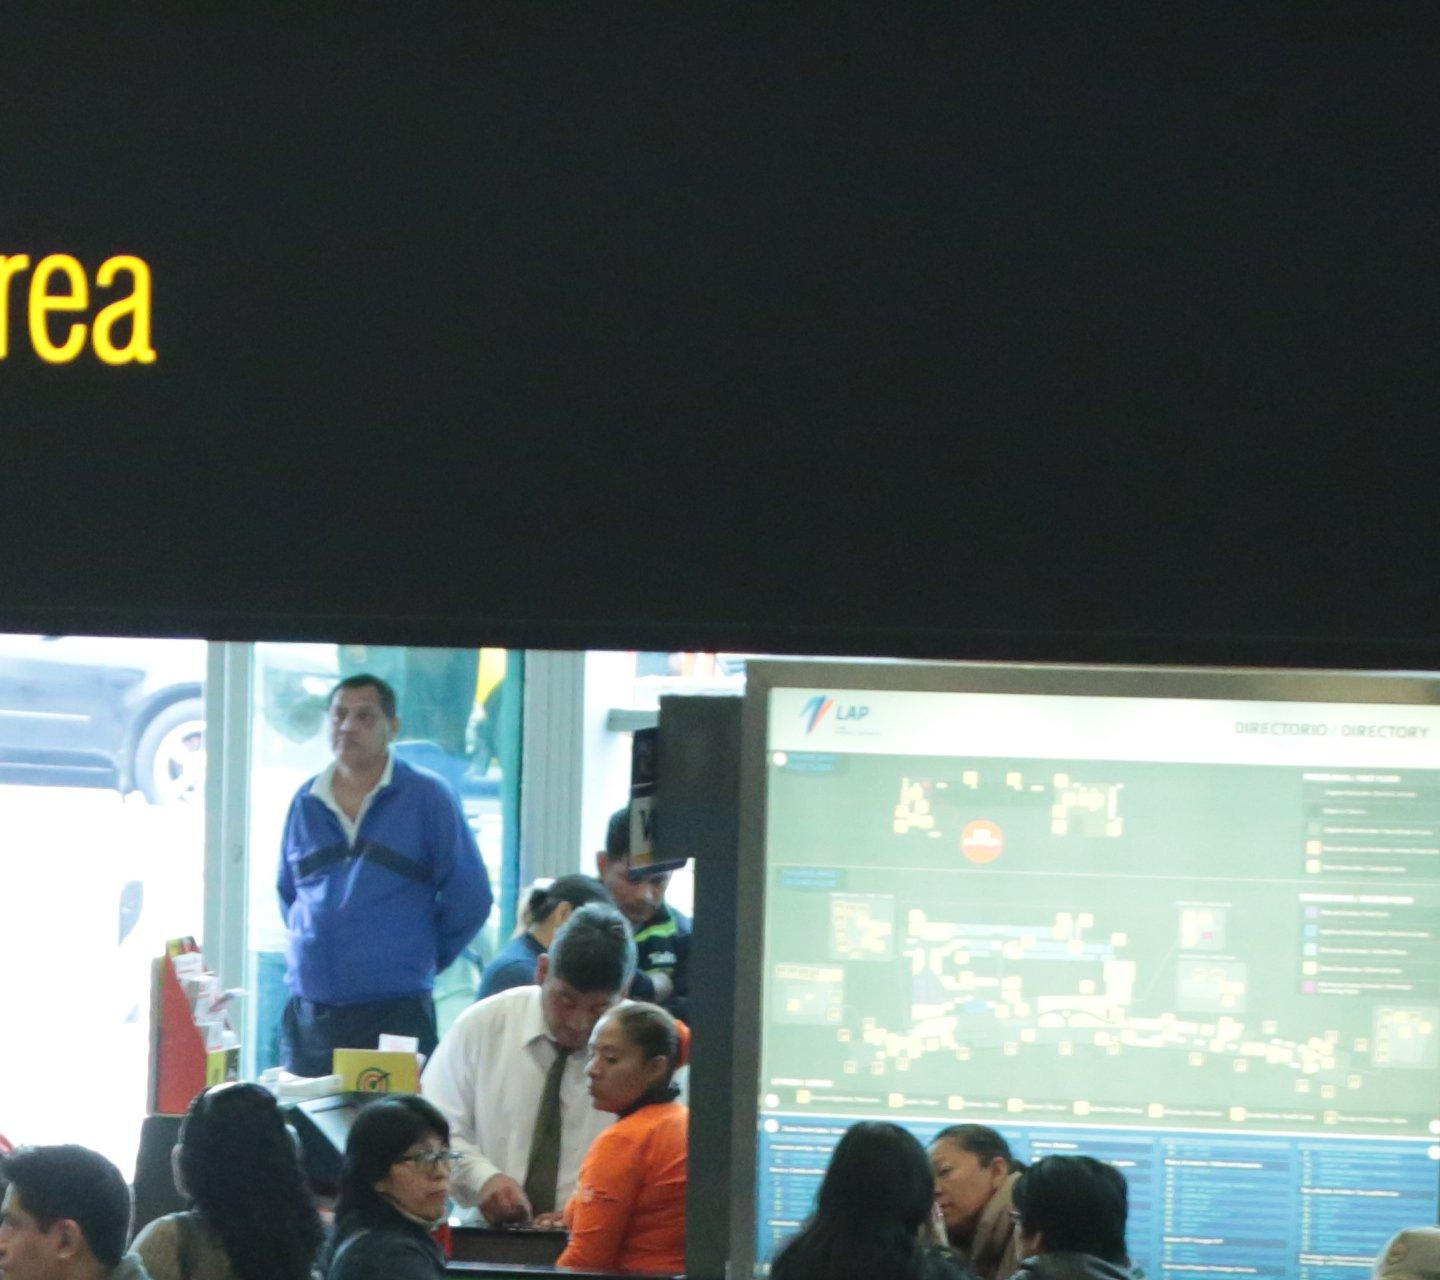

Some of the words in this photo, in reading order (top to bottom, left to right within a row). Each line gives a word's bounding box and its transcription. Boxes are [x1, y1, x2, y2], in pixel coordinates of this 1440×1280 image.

[835, 705, 871, 720] LAP
[1234, 721, 1328, 738] DIRECTORIO
[1340, 724, 1431, 739] DIRECTORY
